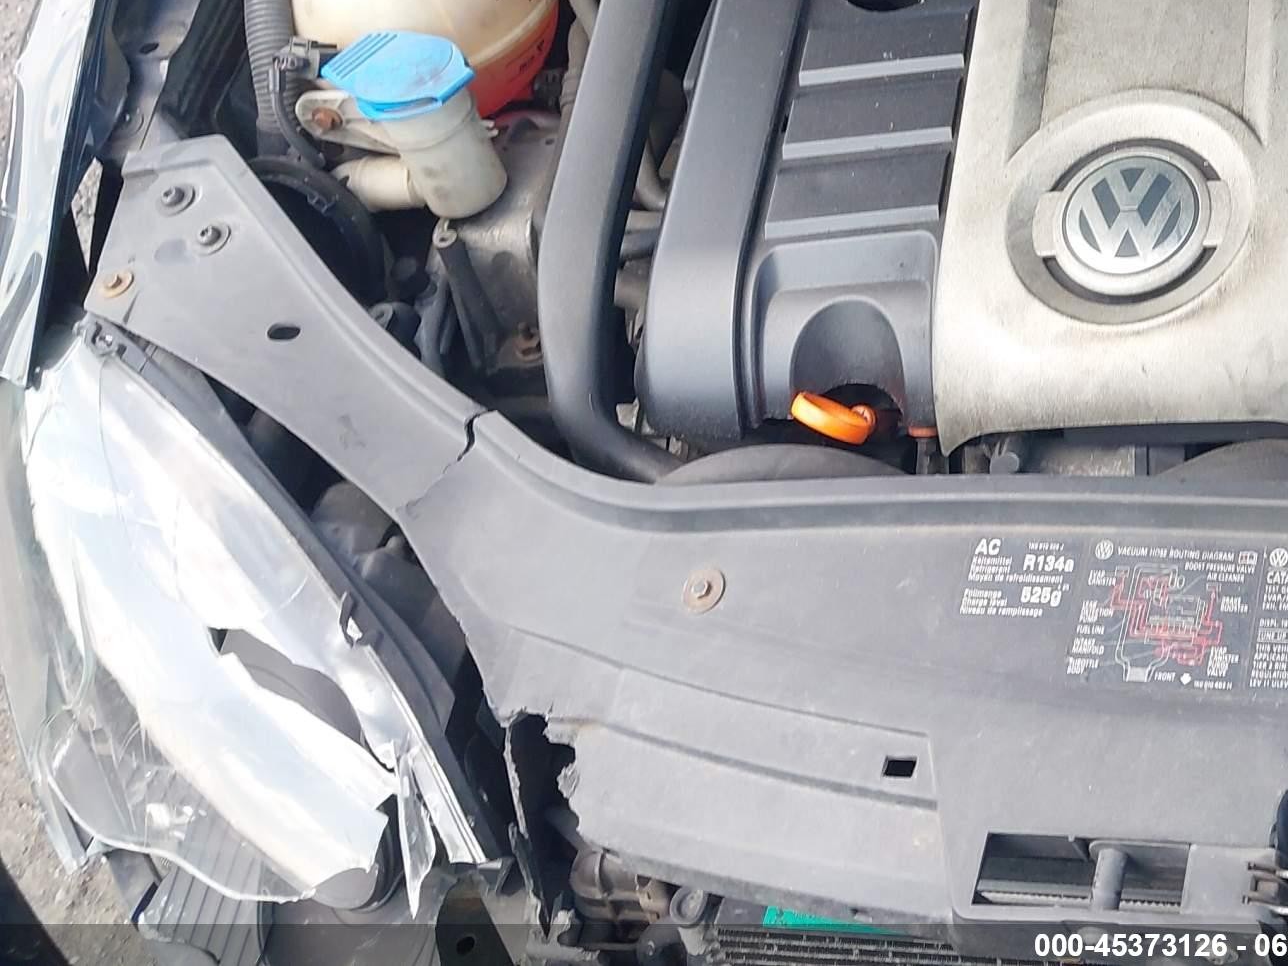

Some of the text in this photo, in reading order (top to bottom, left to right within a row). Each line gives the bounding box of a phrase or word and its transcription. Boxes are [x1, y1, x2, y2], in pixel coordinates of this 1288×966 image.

[975, 538, 1001, 555] AC
[1118, 546, 1148, 557] VACUUM
[1149, 547, 1168, 558] HOSE
[1201, 550, 1235, 562] DIAGRAM
[1023, 554, 1074, 572] R134a
[1184, 562, 1255, 574] BOOST PRESSURE VALVE
[1207, 572, 1245, 583] AIR CLEANER
[1265, 585, 1280, 594] TEST
[1256, 643, 1271, 653] THIS
[1154, 671, 1176, 682] FRONT
